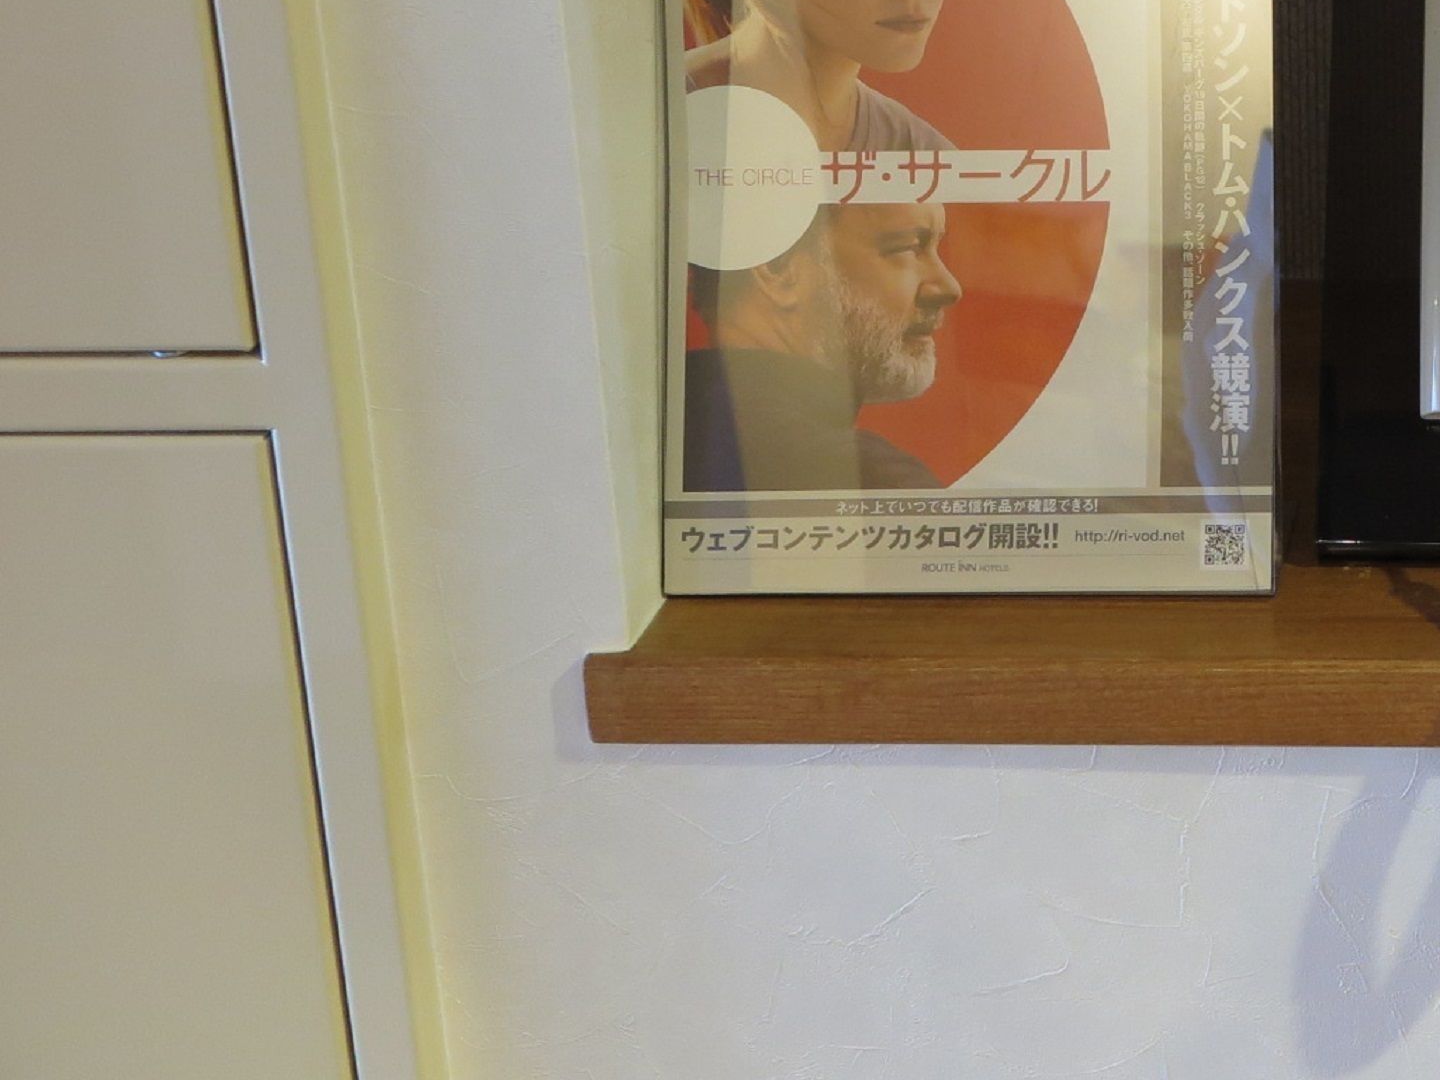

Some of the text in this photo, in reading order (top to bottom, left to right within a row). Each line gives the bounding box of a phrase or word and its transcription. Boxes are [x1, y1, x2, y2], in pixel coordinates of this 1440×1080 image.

[694, 168, 814, 187] THE CIRCLE
[820, 149, 1112, 205] ザ・サークル
[1074, 528, 1186, 545] http://ri-vod.net
[921, 562, 956, 573] ROUTE
